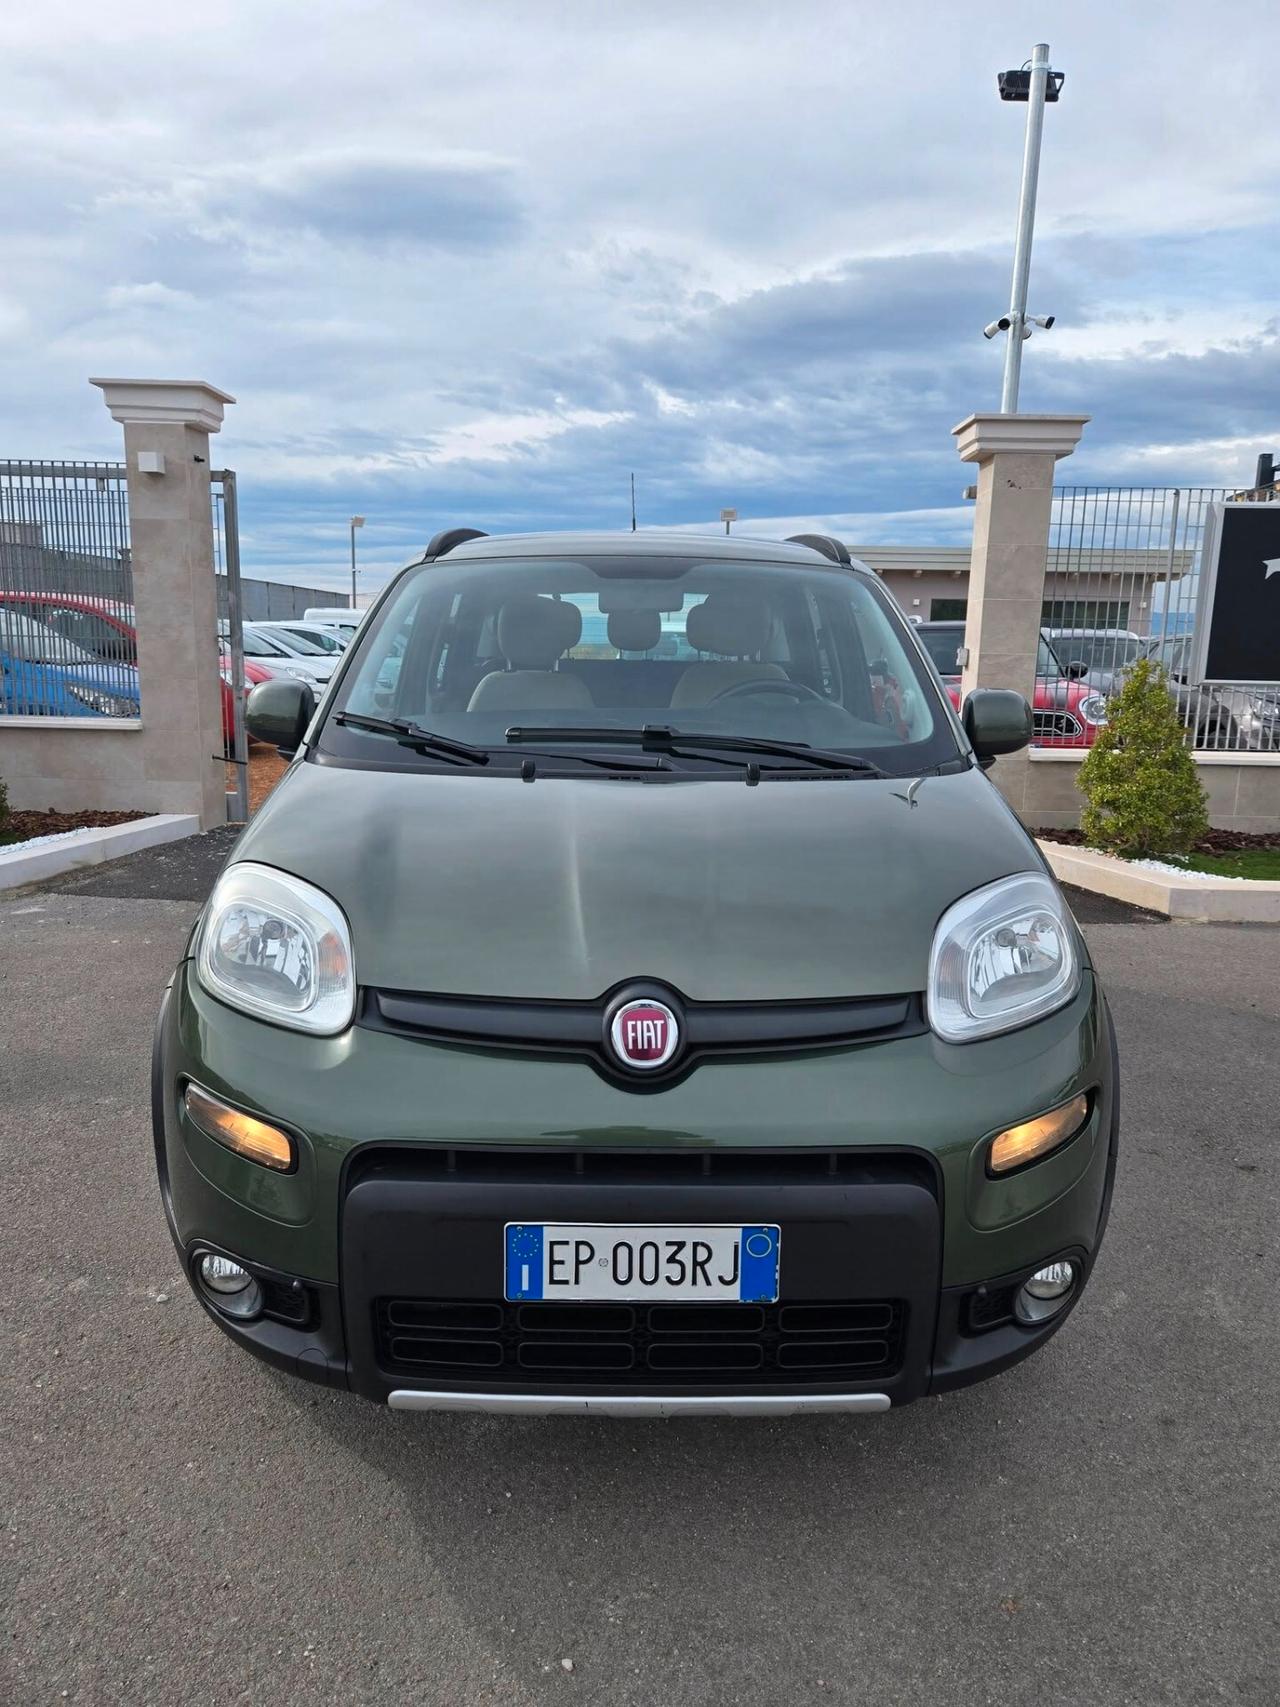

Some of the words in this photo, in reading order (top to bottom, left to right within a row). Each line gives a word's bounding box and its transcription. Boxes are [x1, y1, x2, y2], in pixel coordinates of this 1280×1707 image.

[627, 1020, 665, 1050] FIAT
[548, 1240, 595, 1286] EP
[612, 1240, 739, 1287] 003RJ
